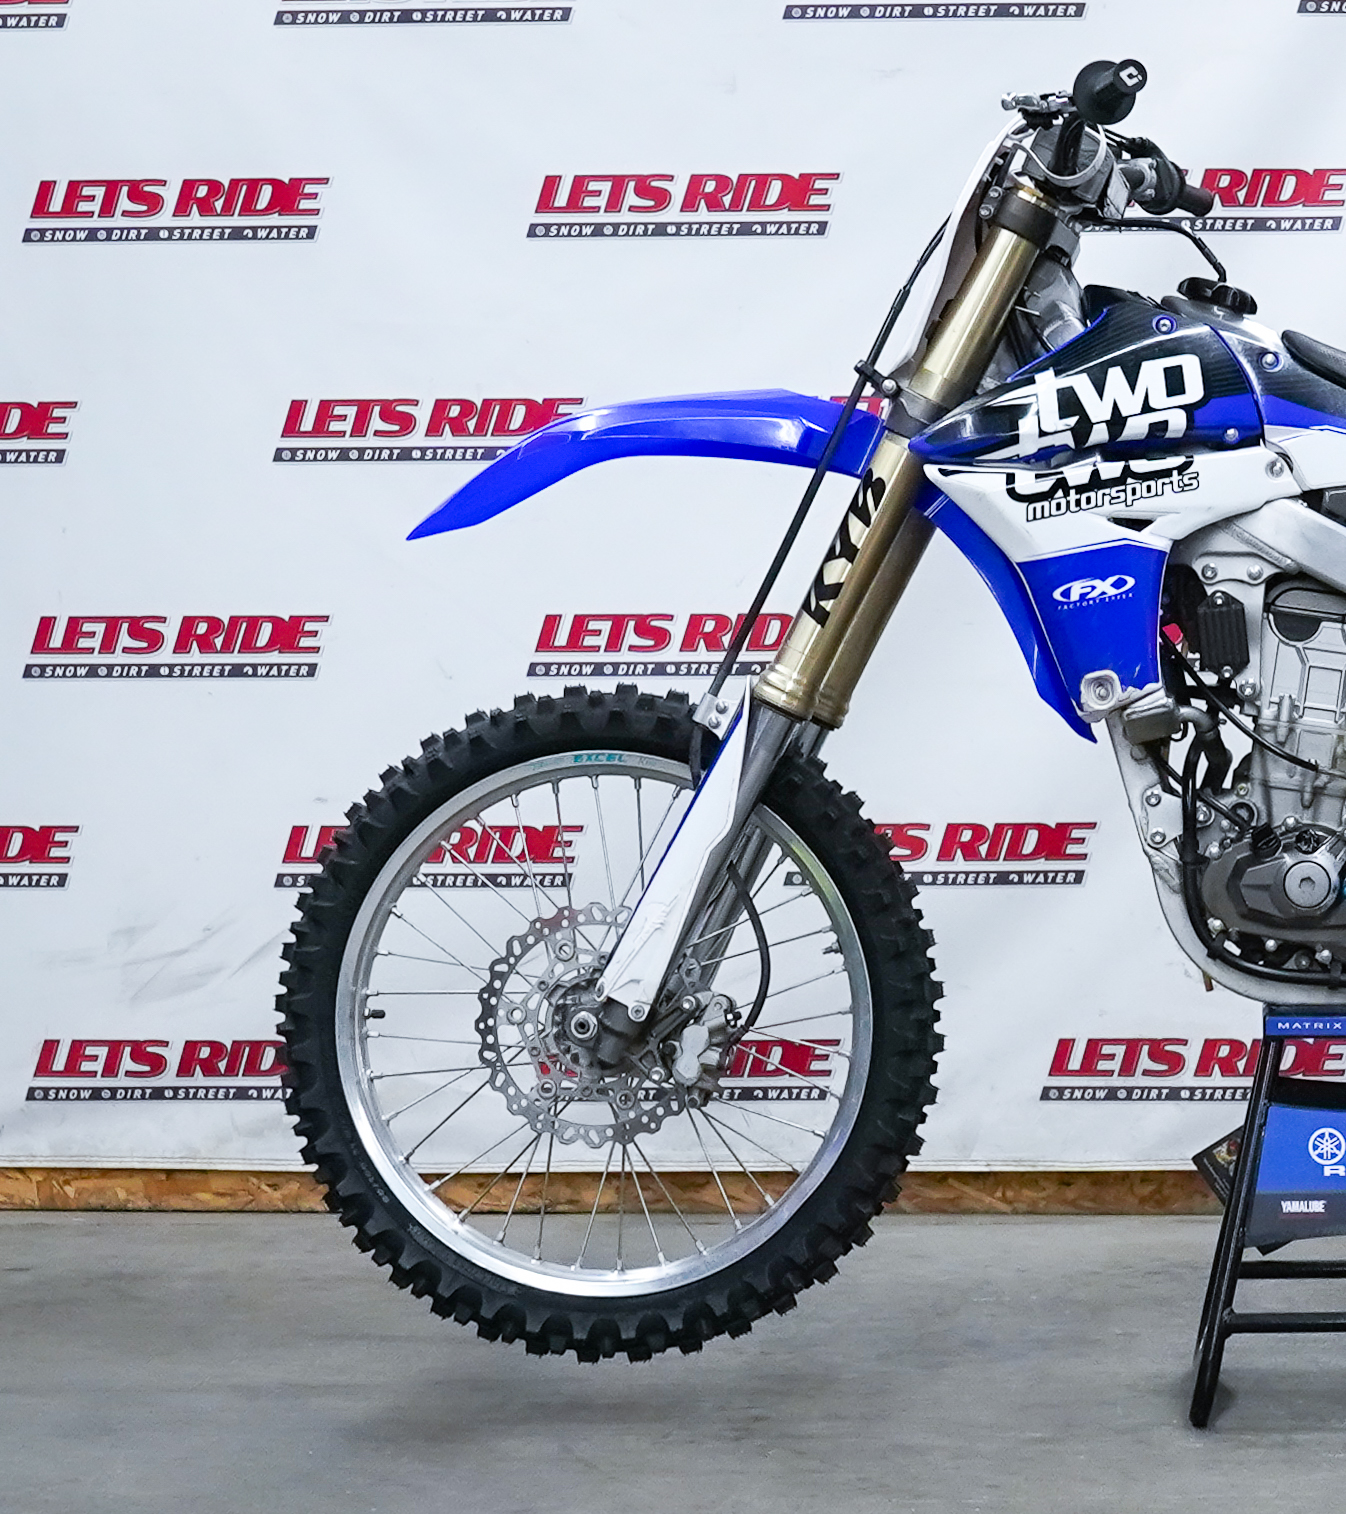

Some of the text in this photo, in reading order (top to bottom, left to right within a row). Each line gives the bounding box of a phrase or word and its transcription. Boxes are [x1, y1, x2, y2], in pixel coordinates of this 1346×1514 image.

[296, 10, 563, 23] SNOW DIRT STREET WATER
[805, 6, 1076, 17] SNOW DIRT STREET WATER
[6, 16, 58, 27] WATER
[30, 177, 330, 218] LETS RIDE
[534, 173, 839, 213] LETS RIDE
[549, 224, 819, 236] SNOW DIRT STREET WATER
[1194, 219, 1333, 230] STREET WATER
[44, 228, 308, 240] SNOW DIRT STREET WATER
[1034, 353, 1205, 433] two
[281, 399, 419, 437] LETS
[5, 452, 57, 462] WATER
[295, 449, 484, 461] SNOW DIRT STREET
[1027, 471, 1200, 522] motorsports
[801, 468, 886, 629] KYB
[1060, 575, 1131, 603] FX
[30, 615, 330, 654] LETS RIDE
[534, 614, 795, 652] LETS RID
[44, 666, 309, 677] SNOW DIRT STREET WATER
[549, 664, 739, 675] SNOW DIRT STRET
[573, 753, 625, 763] EXCEL
[427, 826, 584, 863] RIDE
[936, 822, 1097, 861] RIDE
[8, 876, 59, 886] WATER
[511, 876, 563, 886] WATER
[936, 873, 1076, 884] STREET WATER
[1277, 1022, 1342, 1030] MATRIX
[34, 1040, 290, 1078] LETS RID
[1048, 1039, 1188, 1077] LETS
[48, 1089, 293, 1099] SNOW DIRT STREET WAT
[767, 1089, 820, 1099] WATER
[1063, 1089, 1108, 1099] SNOW
[1132, 1089, 1169, 1099] DIRT
[1280, 1200, 1327, 1213] YAMALUBE
